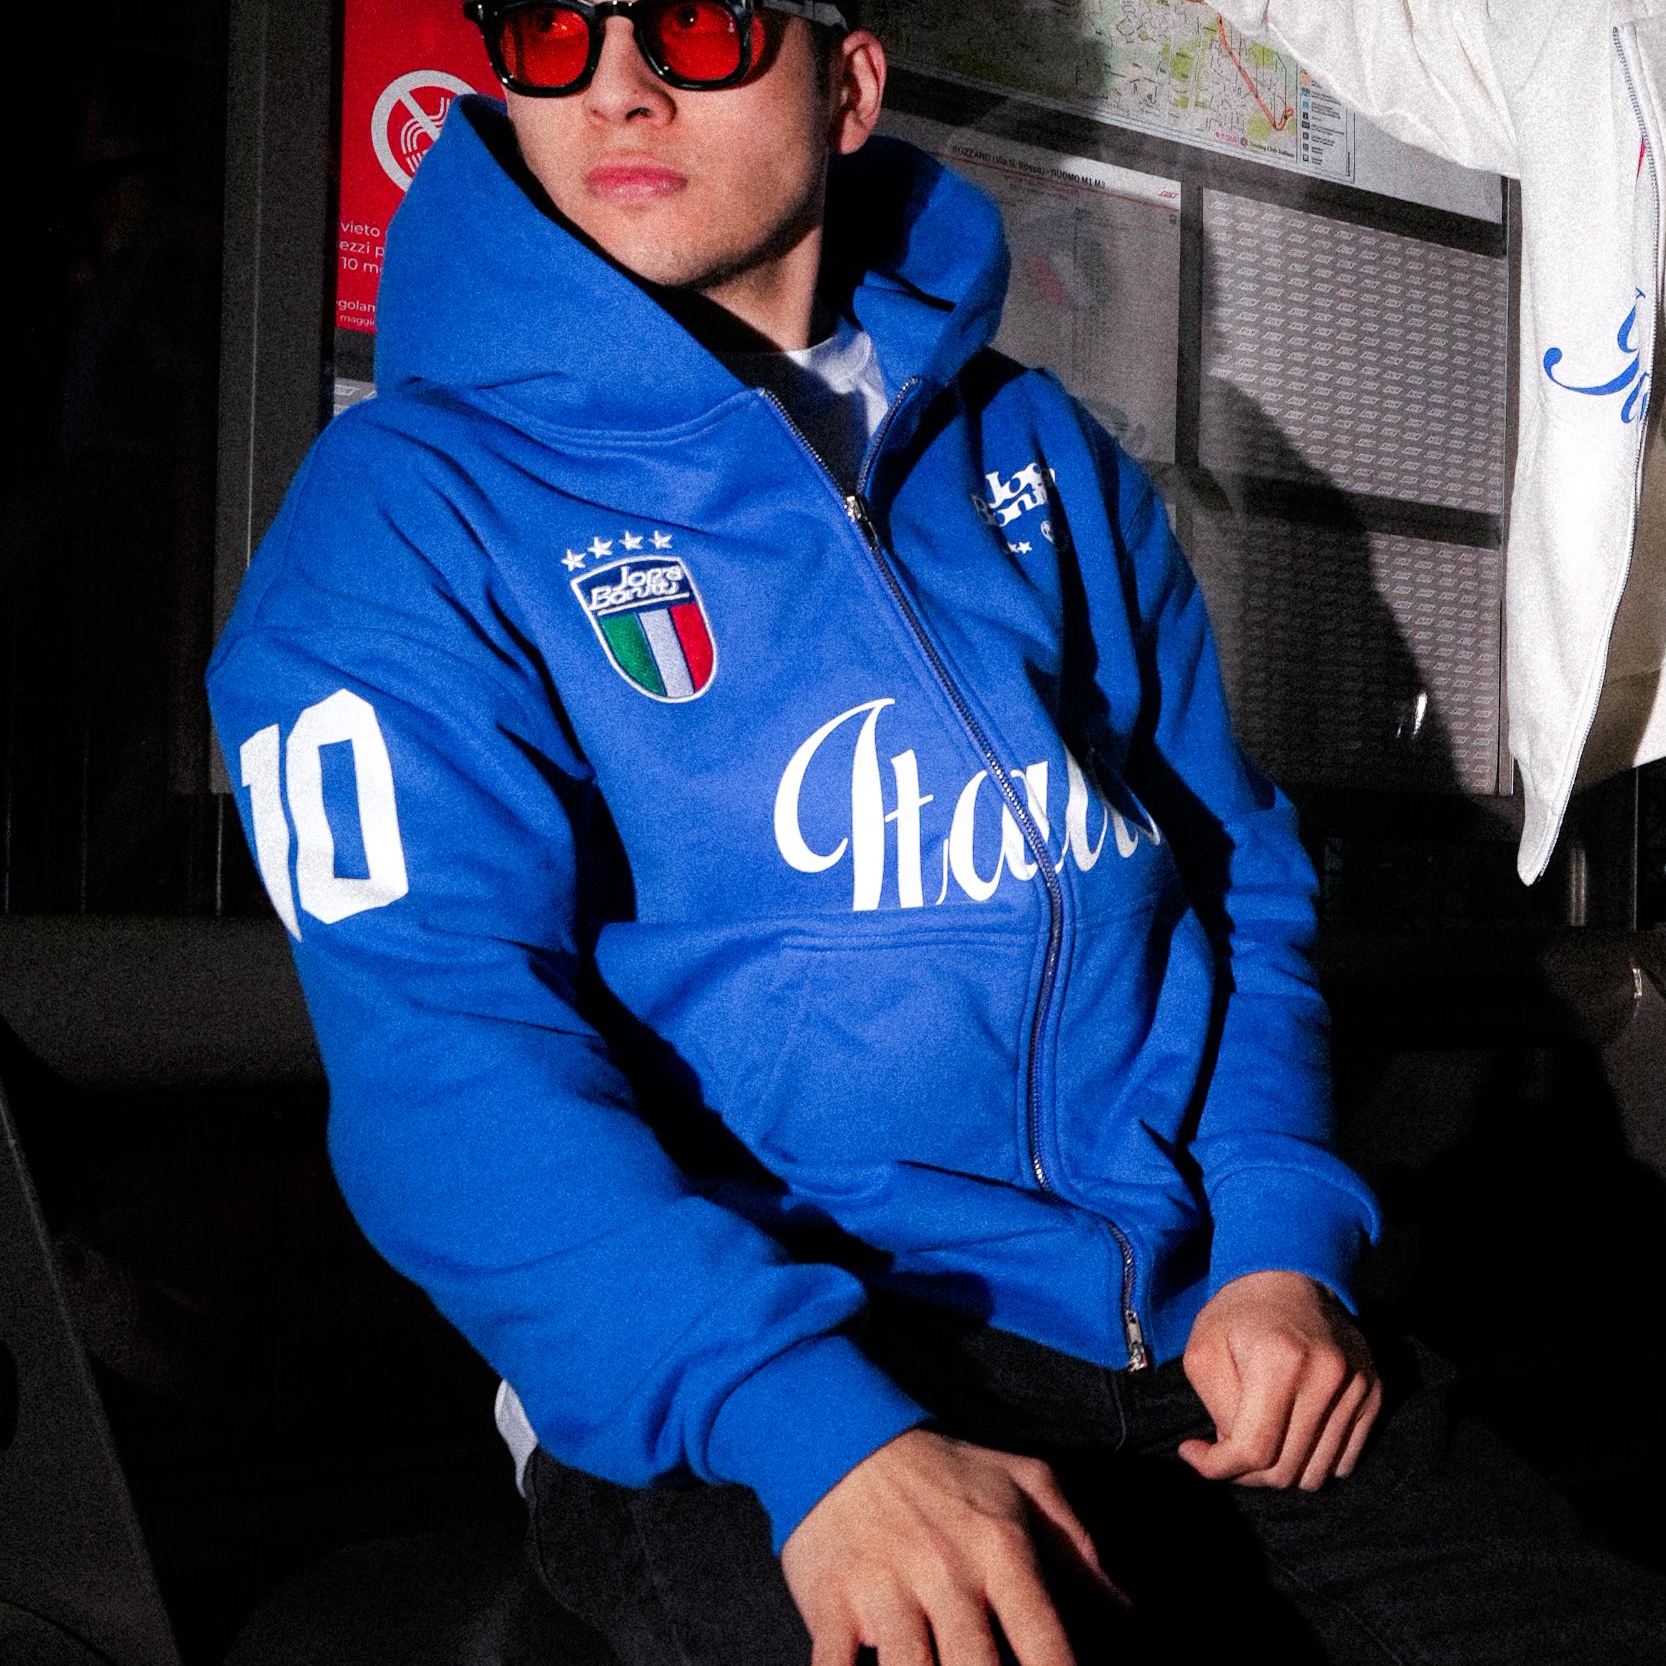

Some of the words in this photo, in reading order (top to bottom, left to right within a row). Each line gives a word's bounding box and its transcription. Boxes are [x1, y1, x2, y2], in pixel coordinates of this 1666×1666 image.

[340, 220, 380, 237] vieto
[338, 240, 370, 255] ezzi
[341, 255, 358, 270] 10
[239, 687, 409, 943] 10
